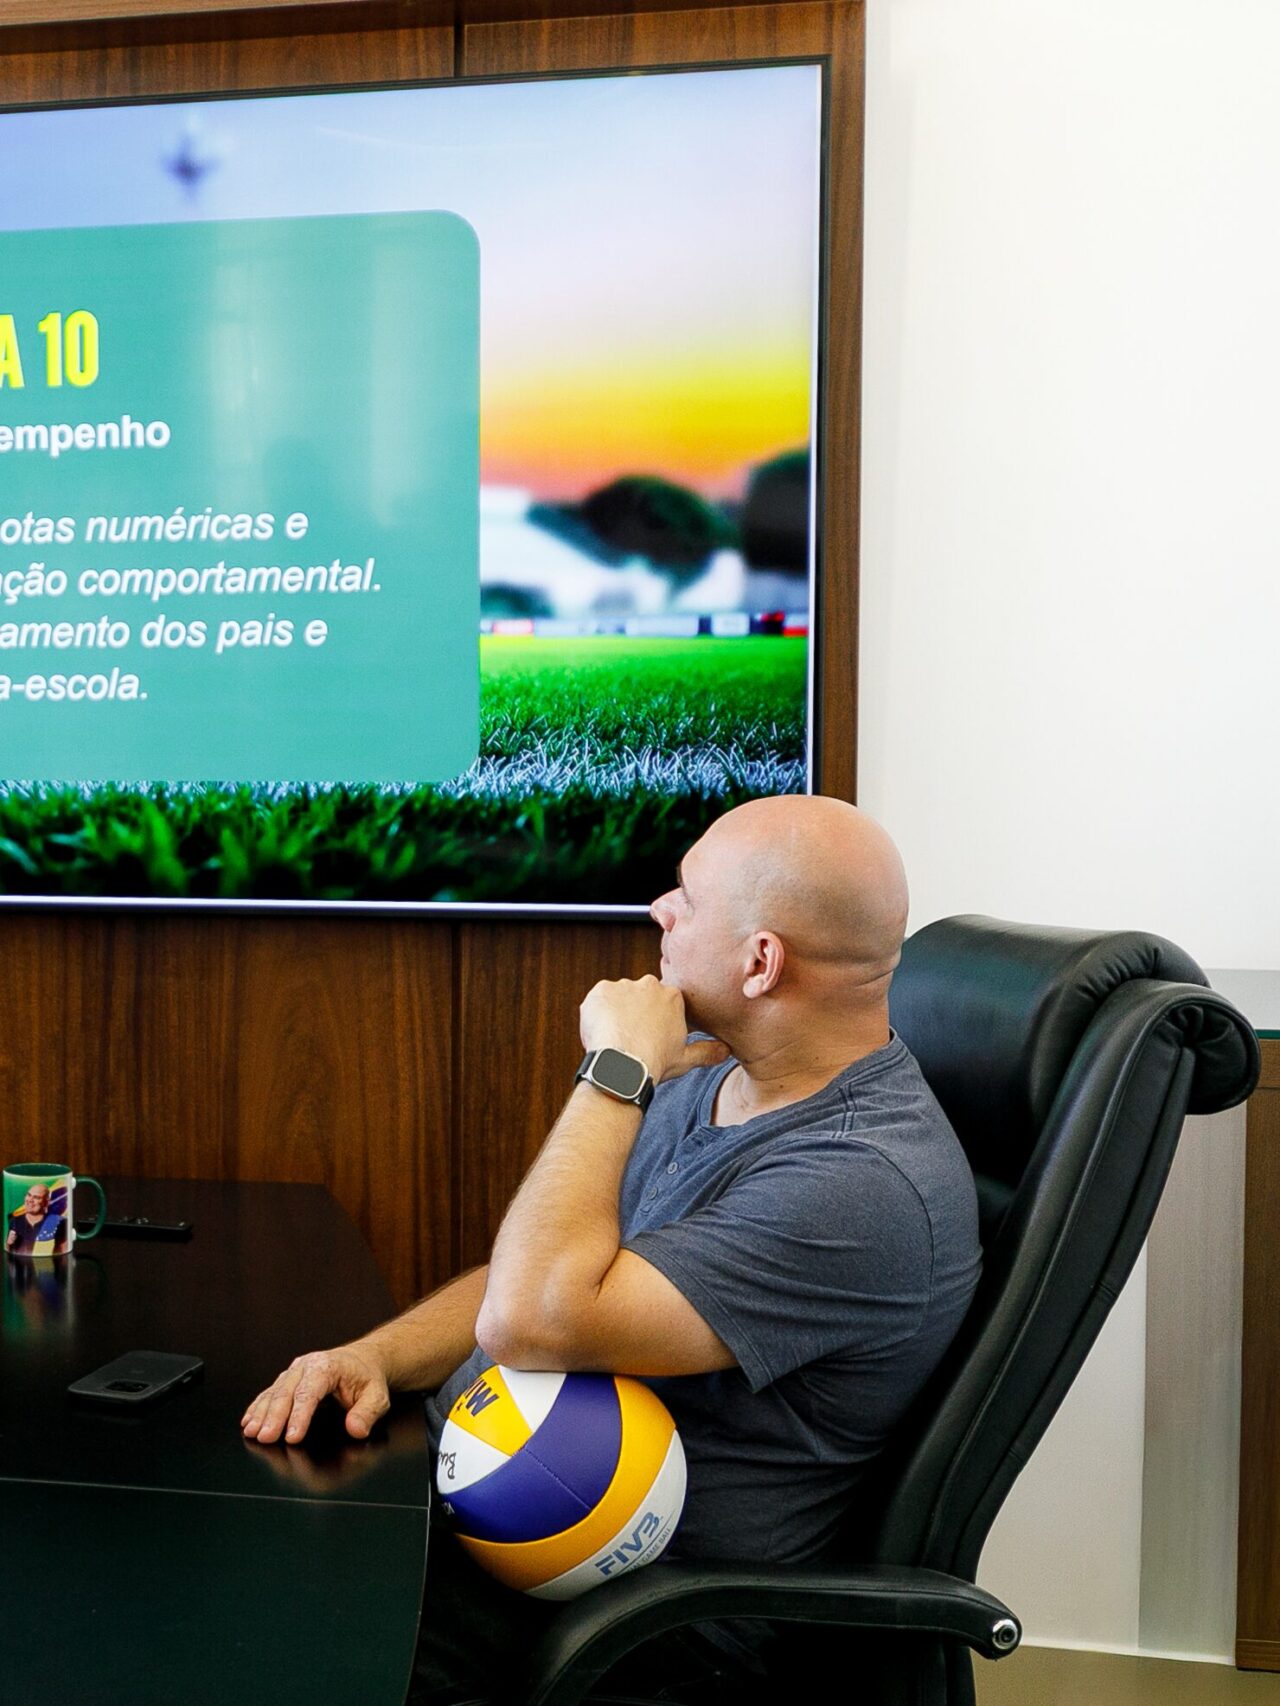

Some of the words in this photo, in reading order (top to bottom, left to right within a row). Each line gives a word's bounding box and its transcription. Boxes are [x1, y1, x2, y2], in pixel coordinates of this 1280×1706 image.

[37, 310, 100, 388] 10
[86, 507, 274, 543] numéricas
[285, 512, 308, 539] e
[78, 558, 382, 602] comportamental.
[141, 614, 207, 647] dos
[216, 614, 294, 653] pais
[304, 618, 328, 646] e
